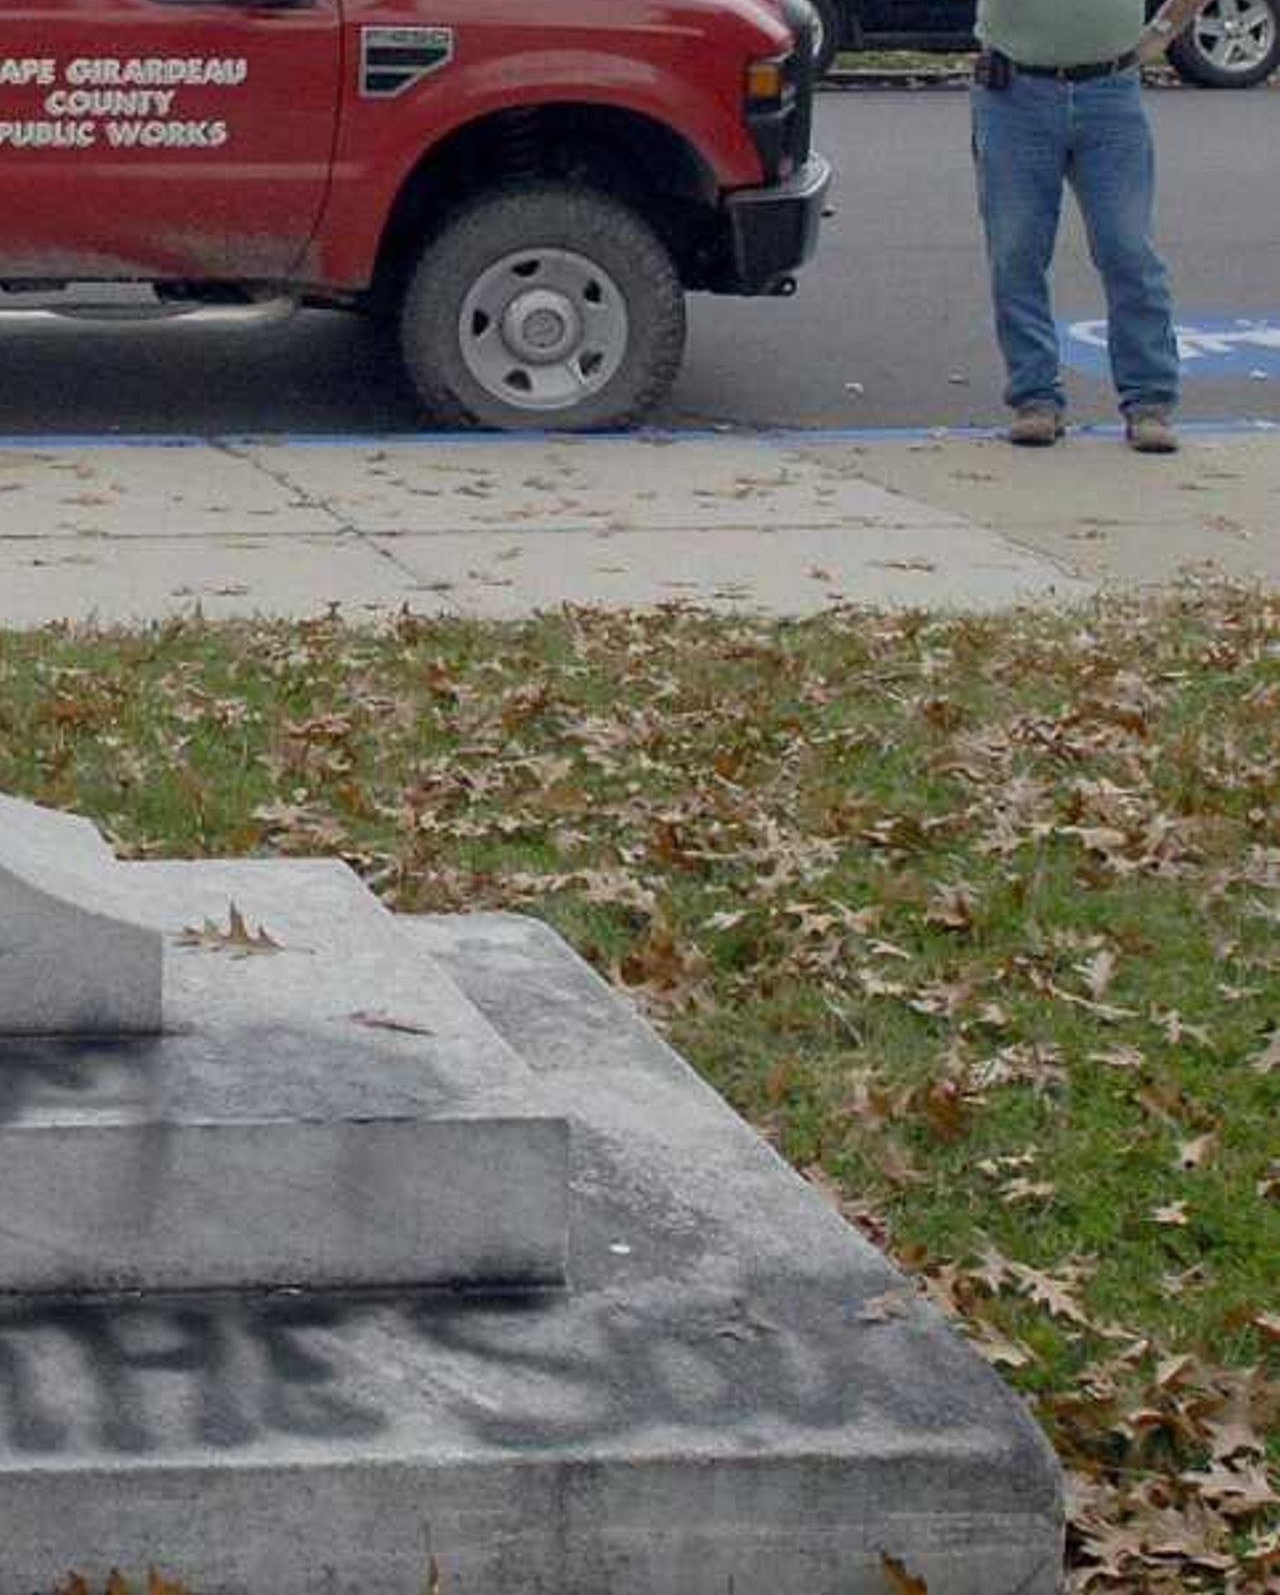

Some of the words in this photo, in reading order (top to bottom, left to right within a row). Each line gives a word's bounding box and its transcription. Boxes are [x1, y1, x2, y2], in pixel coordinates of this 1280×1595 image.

[65, 58, 246, 84] GIRARDEAU
[44, 90, 174, 115] COUNTY
[107, 122, 227, 147] WORKS
